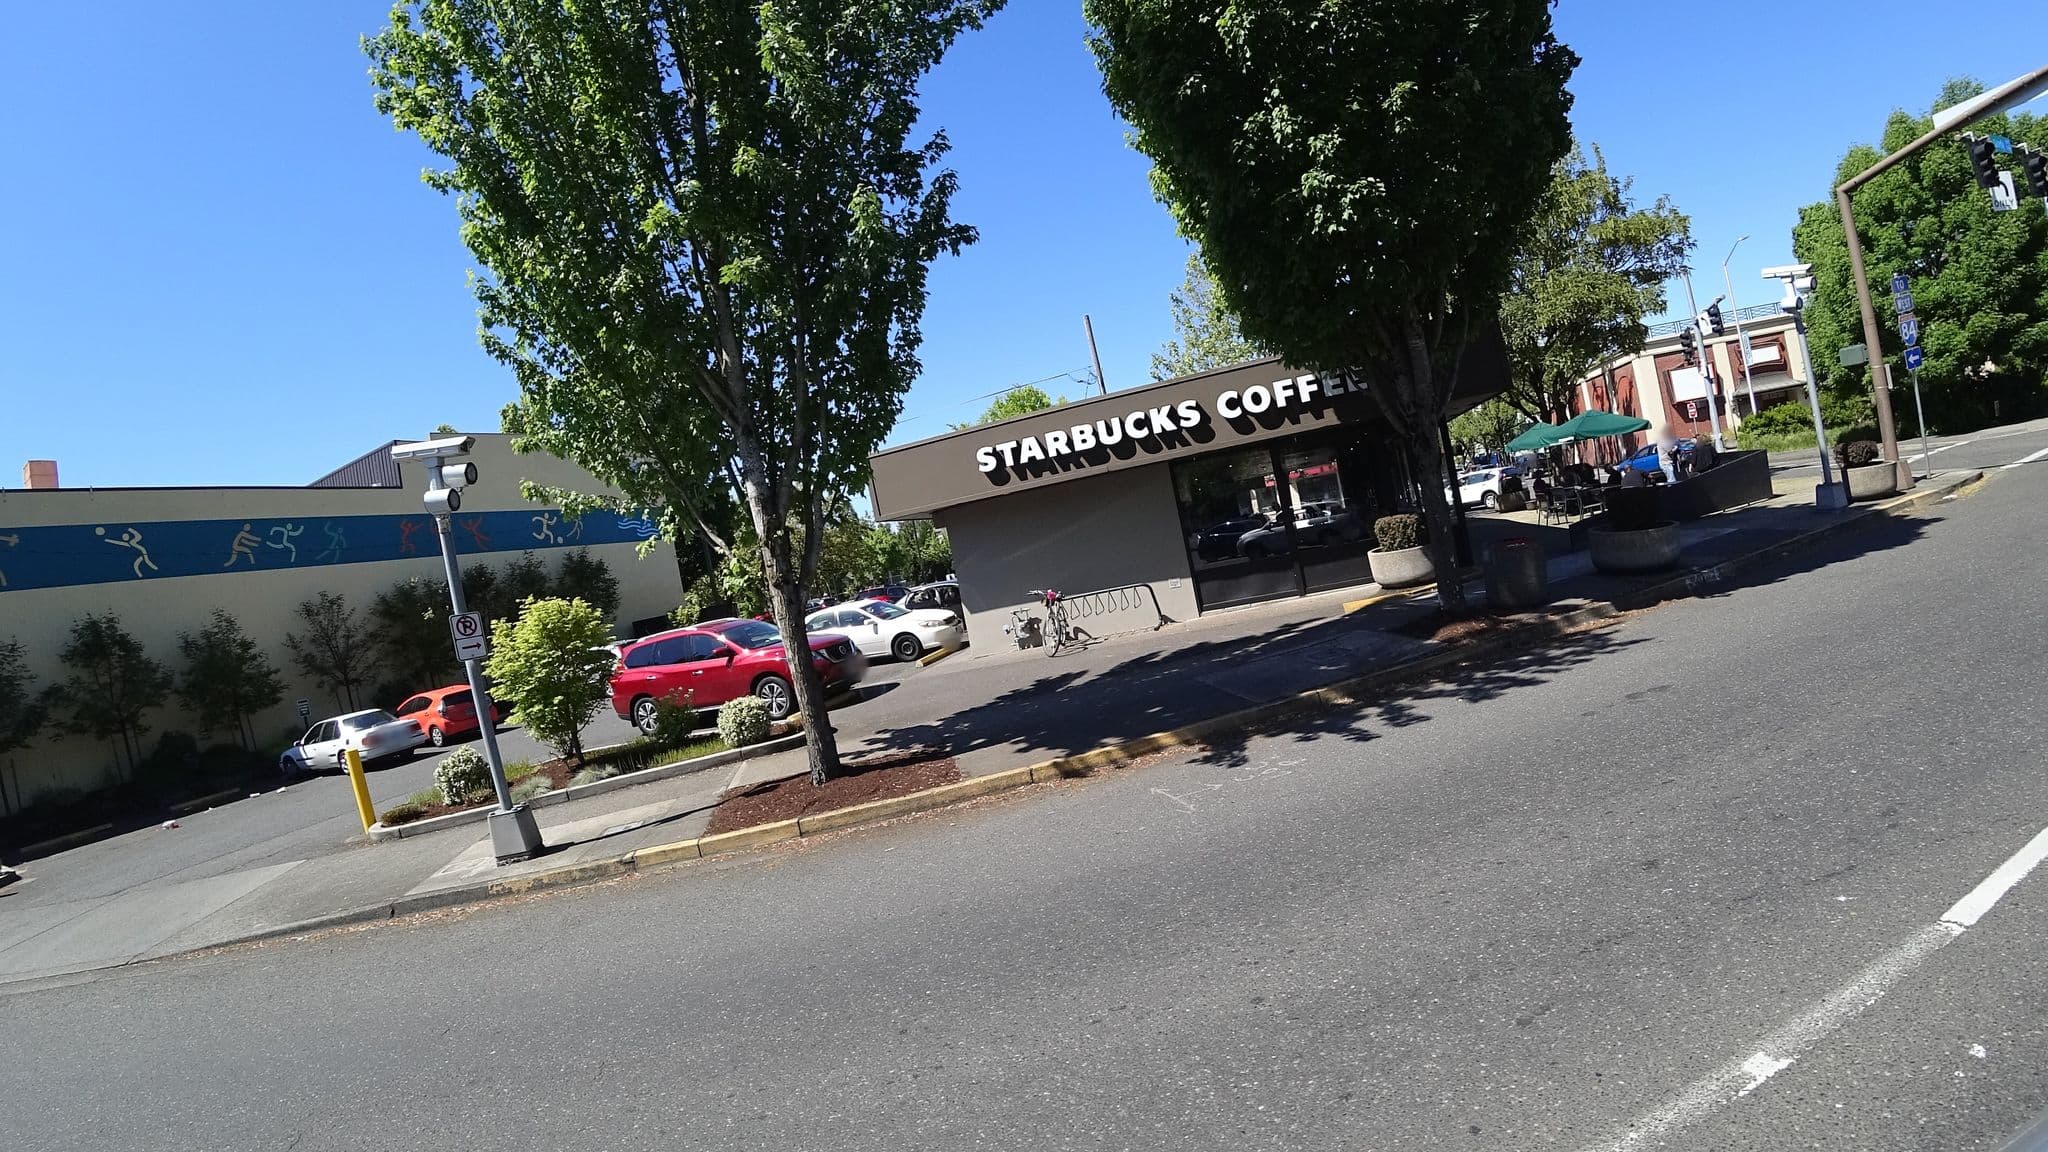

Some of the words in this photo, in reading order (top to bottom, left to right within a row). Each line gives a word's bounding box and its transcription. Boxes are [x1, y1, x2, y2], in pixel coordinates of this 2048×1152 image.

[1994, 199, 2015, 209] ONLY
[1895, 279, 1904, 289] TO
[1901, 321, 1915, 340] 84
[976, 399, 1201, 472] STARBUCKS
